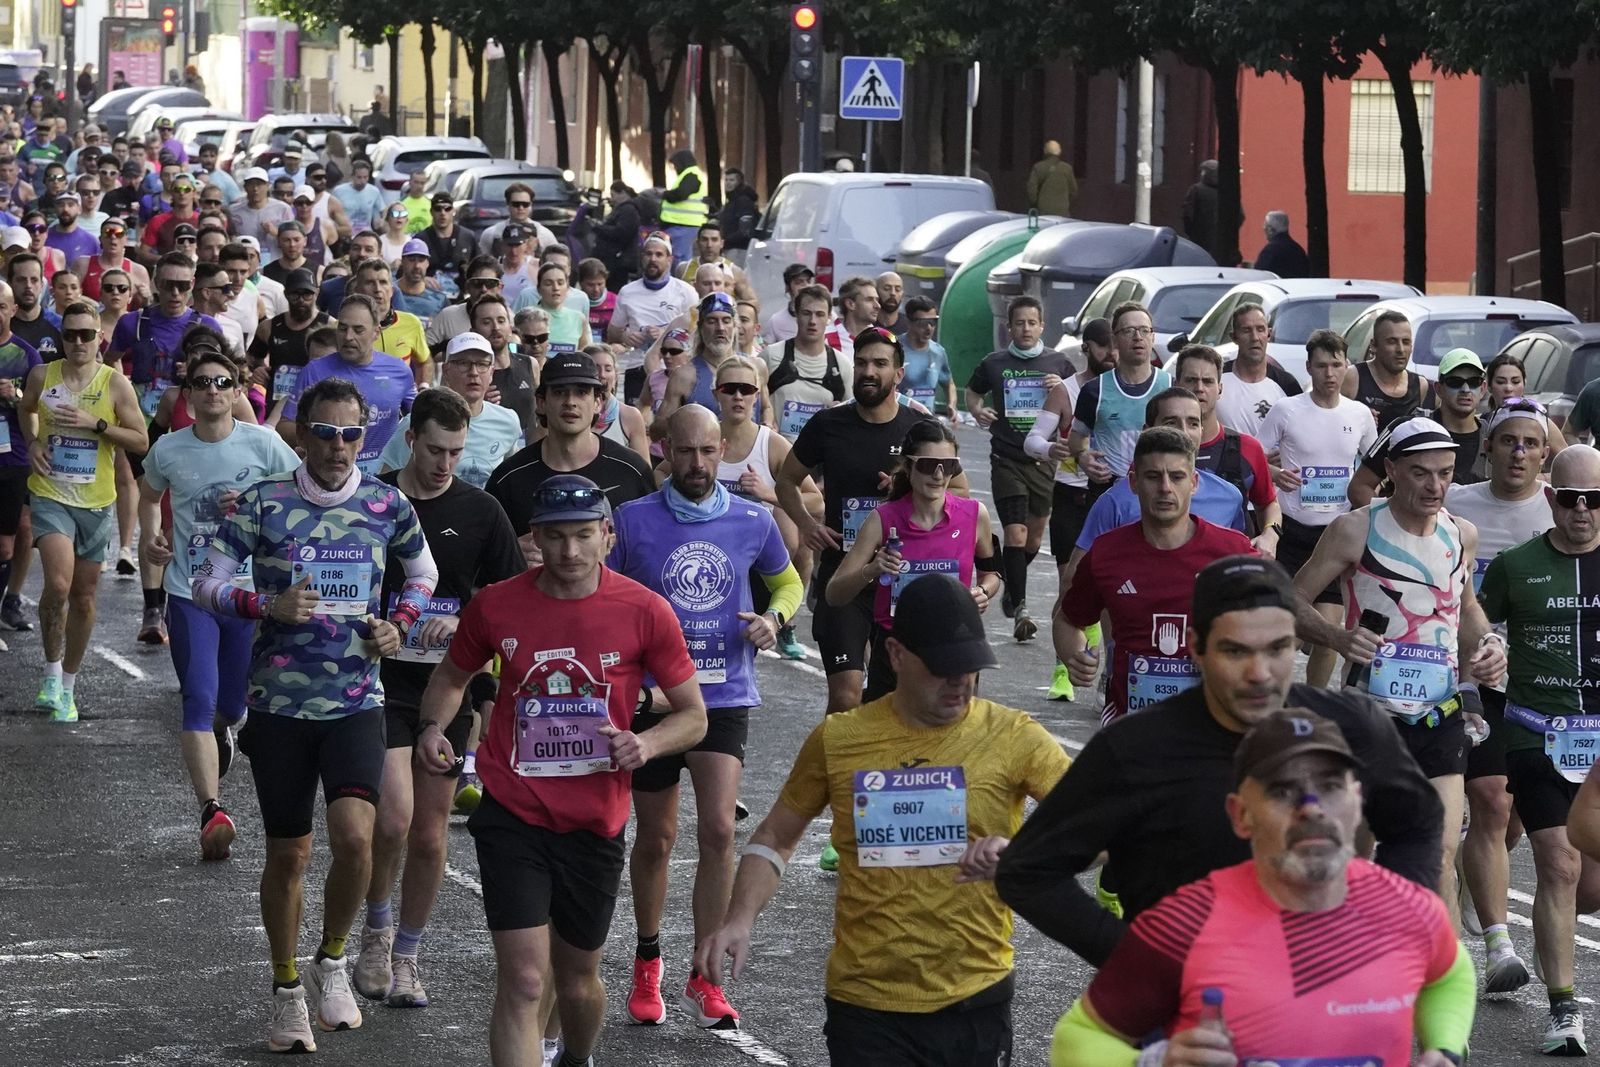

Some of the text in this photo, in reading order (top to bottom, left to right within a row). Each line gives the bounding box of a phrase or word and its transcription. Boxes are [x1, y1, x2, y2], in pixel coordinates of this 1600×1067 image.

[1012, 399, 1039, 408] JORGE
[64, 439, 93, 448] ZURICH
[65, 465, 96, 475] GONZÁLEZ
[320, 550, 364, 560] ZURICH
[671, 543, 728, 562] CLUB DEPORTIVO
[914, 562, 951, 571] ZURICH
[320, 570, 344, 580] 8186
[691, 595, 726, 610] CARMONA
[1546, 594, 1600, 608] ABELLÁ
[684, 620, 719, 629] ZURICH
[1542, 634, 1571, 644] JOSE
[686, 640, 707, 650] 7665
[1400, 647, 1441, 660] ZURICH
[705, 657, 726, 669] CAPI
[1153, 662, 1199, 673] ZURICH
[1398, 667, 1422, 679] 5577
[1533, 674, 1593, 688] AVANZA
[1154, 684, 1179, 694] 8339
[1389, 681, 1428, 699] C.R.A
[546, 703, 597, 713] ZURICH
[546, 724, 579, 737] 10120
[534, 739, 594, 758] GUITOU
[1573, 738, 1595, 748] 7527
[892, 771, 952, 787] ZURICH
[893, 801, 925, 815] 6907
[857, 824, 966, 844] JOSÉ VICENTE
